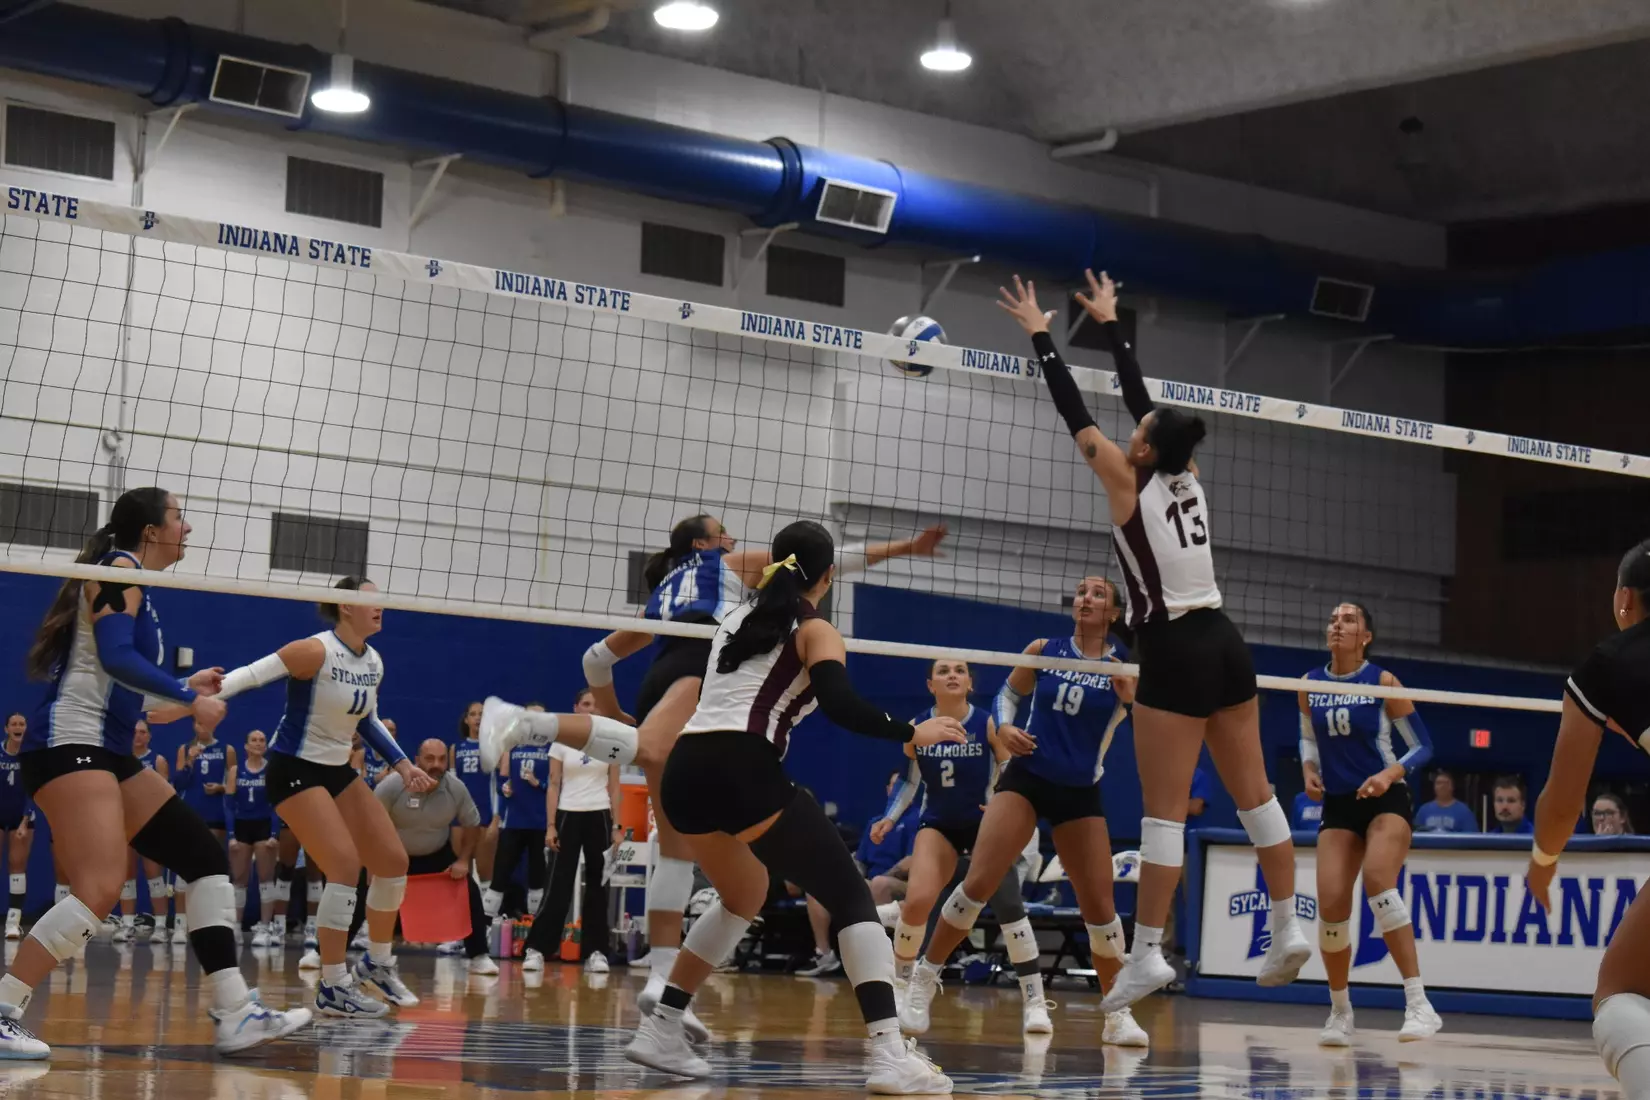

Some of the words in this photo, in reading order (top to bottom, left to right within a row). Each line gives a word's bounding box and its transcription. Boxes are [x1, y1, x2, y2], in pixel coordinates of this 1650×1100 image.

[8, 186, 78, 219] STATE
[217, 223, 300, 256] INDIANA
[308, 238, 372, 268] STATE
[495, 270, 567, 301] INDIANA
[575, 284, 631, 311] STATE
[741, 312, 806, 340] INDIANA
[812, 324, 863, 349] STATE
[961, 349, 1020, 375] INDIANA
[1161, 381, 1214, 406] INDIANA
[1219, 391, 1261, 413] STATE
[1341, 411, 1390, 434] INDIANA
[1395, 419, 1434, 440] STATE
[1507, 436, 1552, 458] INDIANA
[1555, 444, 1591, 464] STATE
[1165, 496, 1207, 548] 13
[659, 567, 699, 621] 14
[1042, 667, 1113, 691] CAMORES
[347, 688, 368, 715] 11
[1052, 682, 1085, 716] 19
[1308, 693, 1376, 707] SYCAMORES
[1325, 707, 1351, 737] 18
[463, 757, 480, 773] 22
[916, 743, 983, 758] SYCAMORES
[940, 759, 955, 788] 2
[248, 786, 255, 802] 1
[1230, 892, 1316, 919] SYCAES
